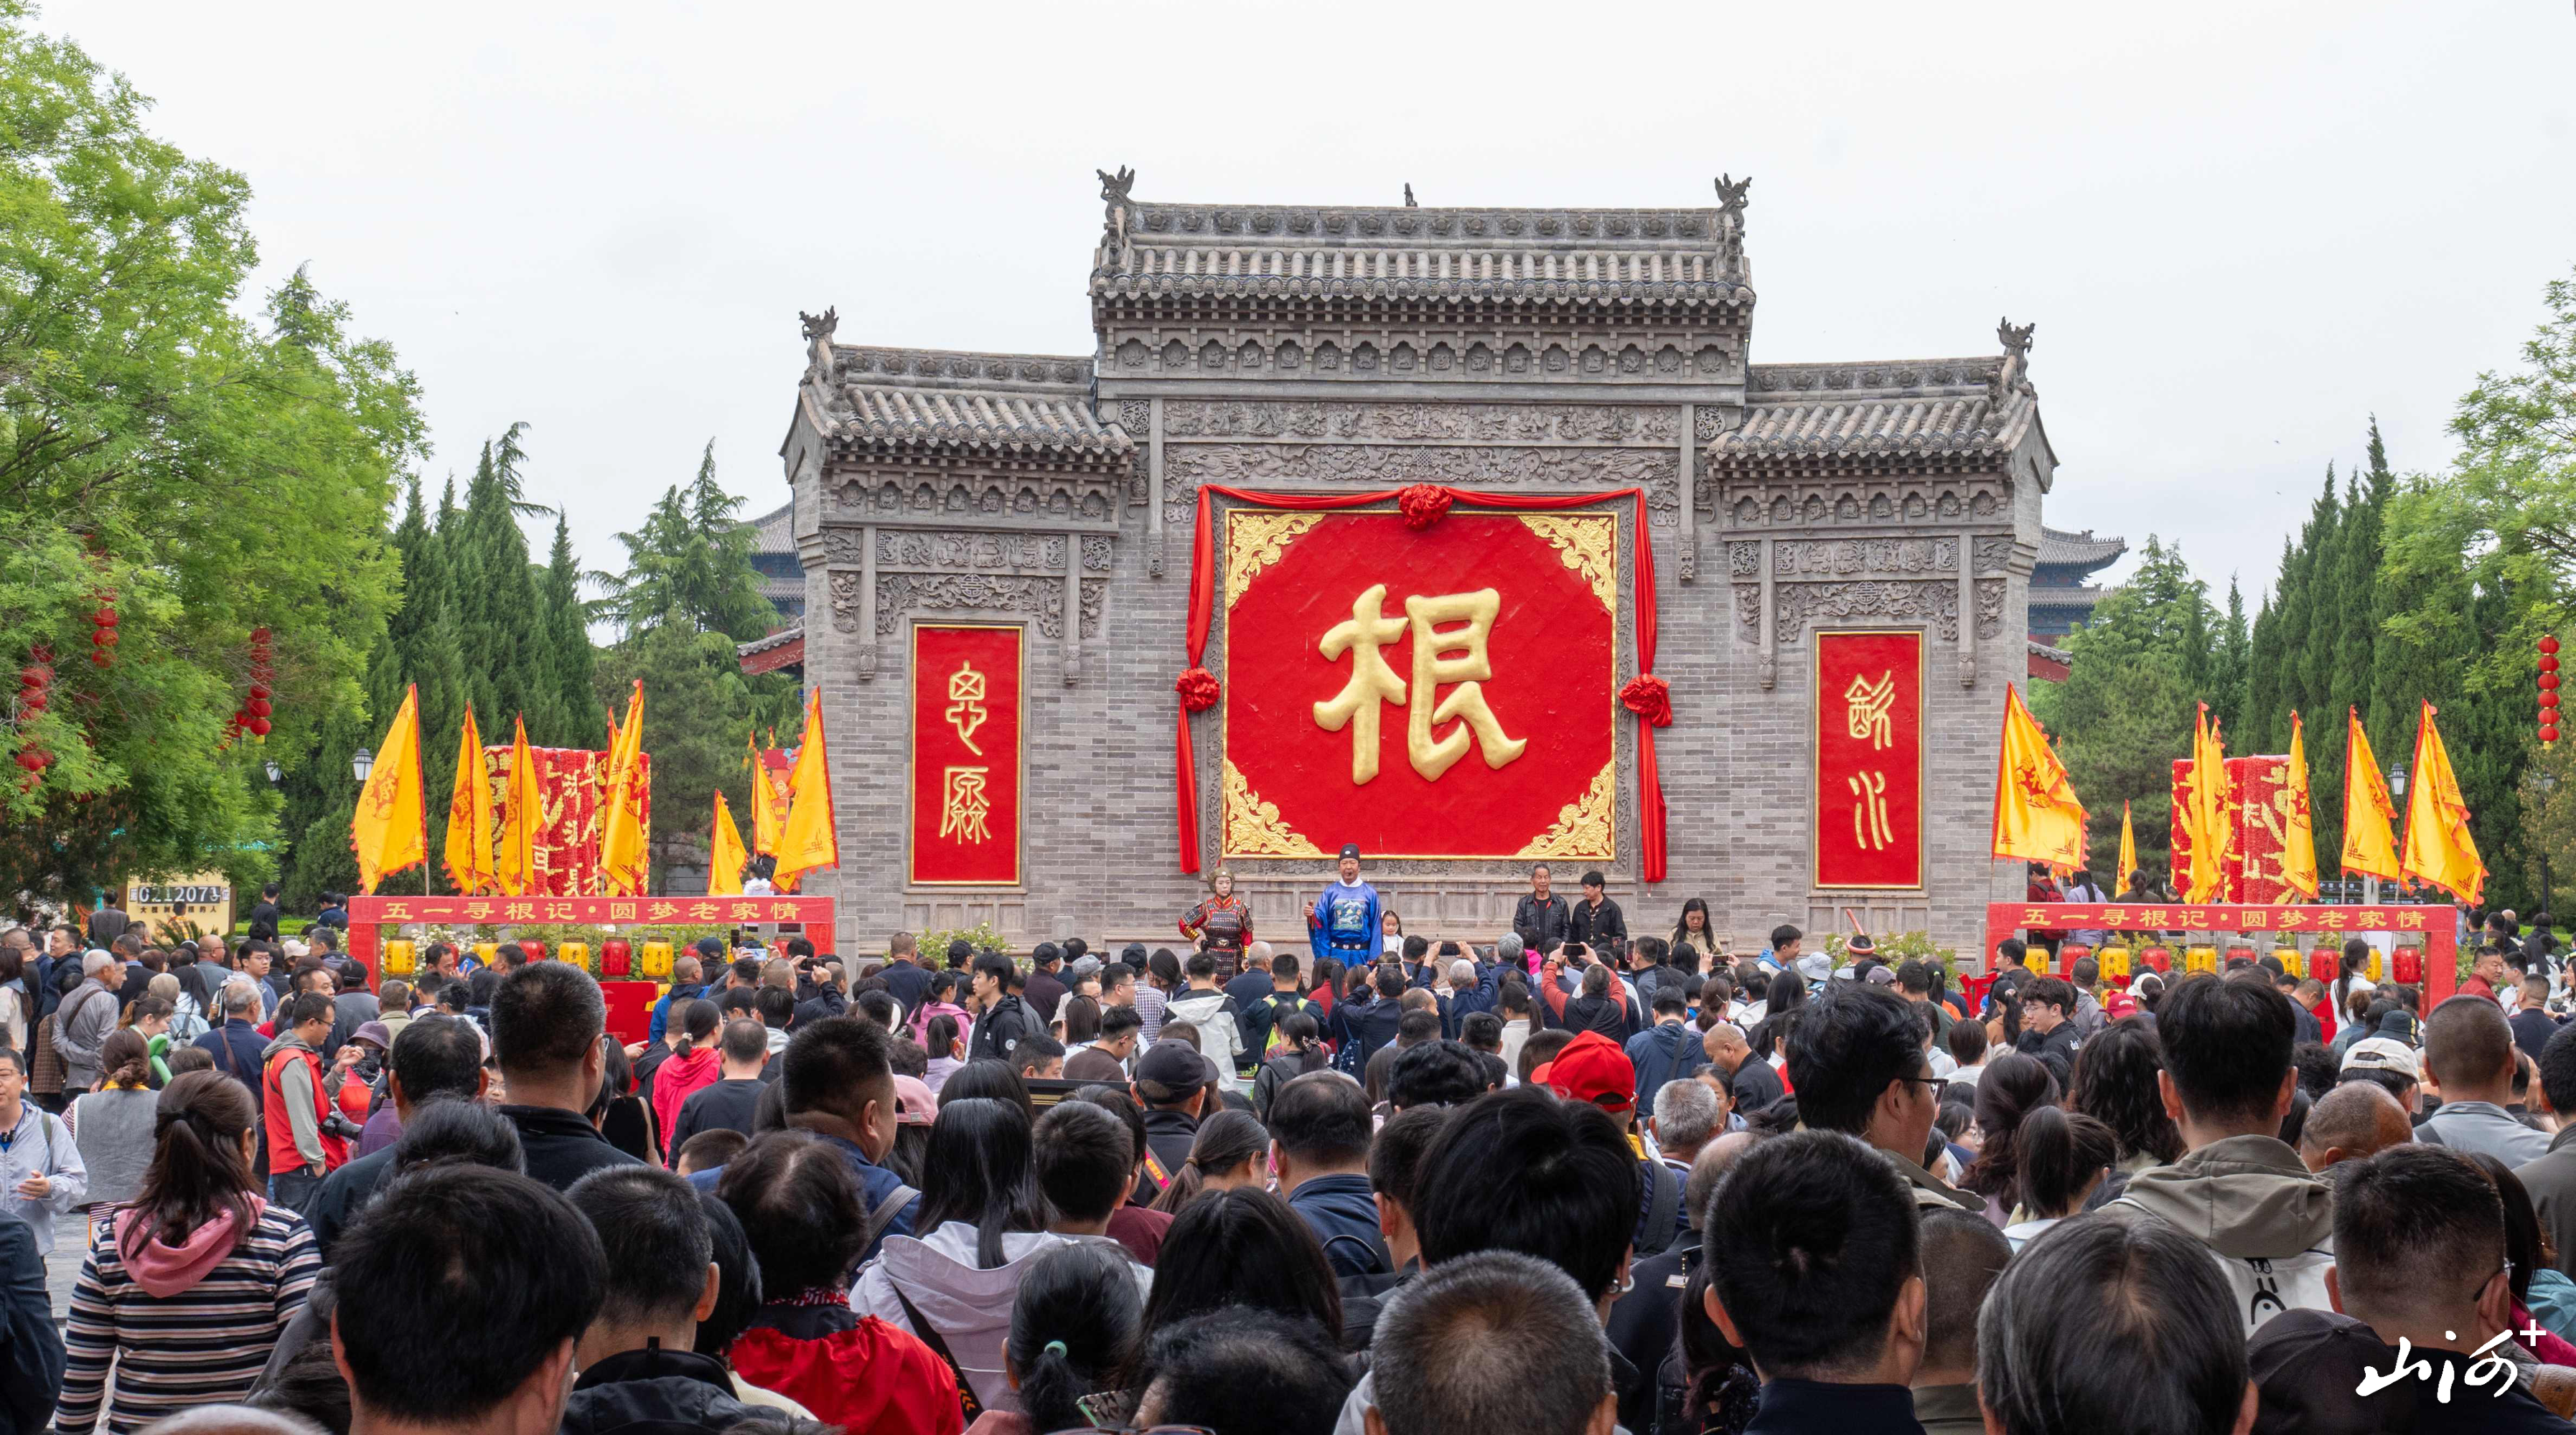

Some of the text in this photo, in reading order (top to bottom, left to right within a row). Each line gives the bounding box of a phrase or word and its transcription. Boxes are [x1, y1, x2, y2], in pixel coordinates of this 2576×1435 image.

[1313, 583, 1527, 786] 根
[380, 901, 802, 921] 五一寻根记·圆梦老家情
[2020, 908, 2426, 929] 五一寻根记·圆梦老家情
